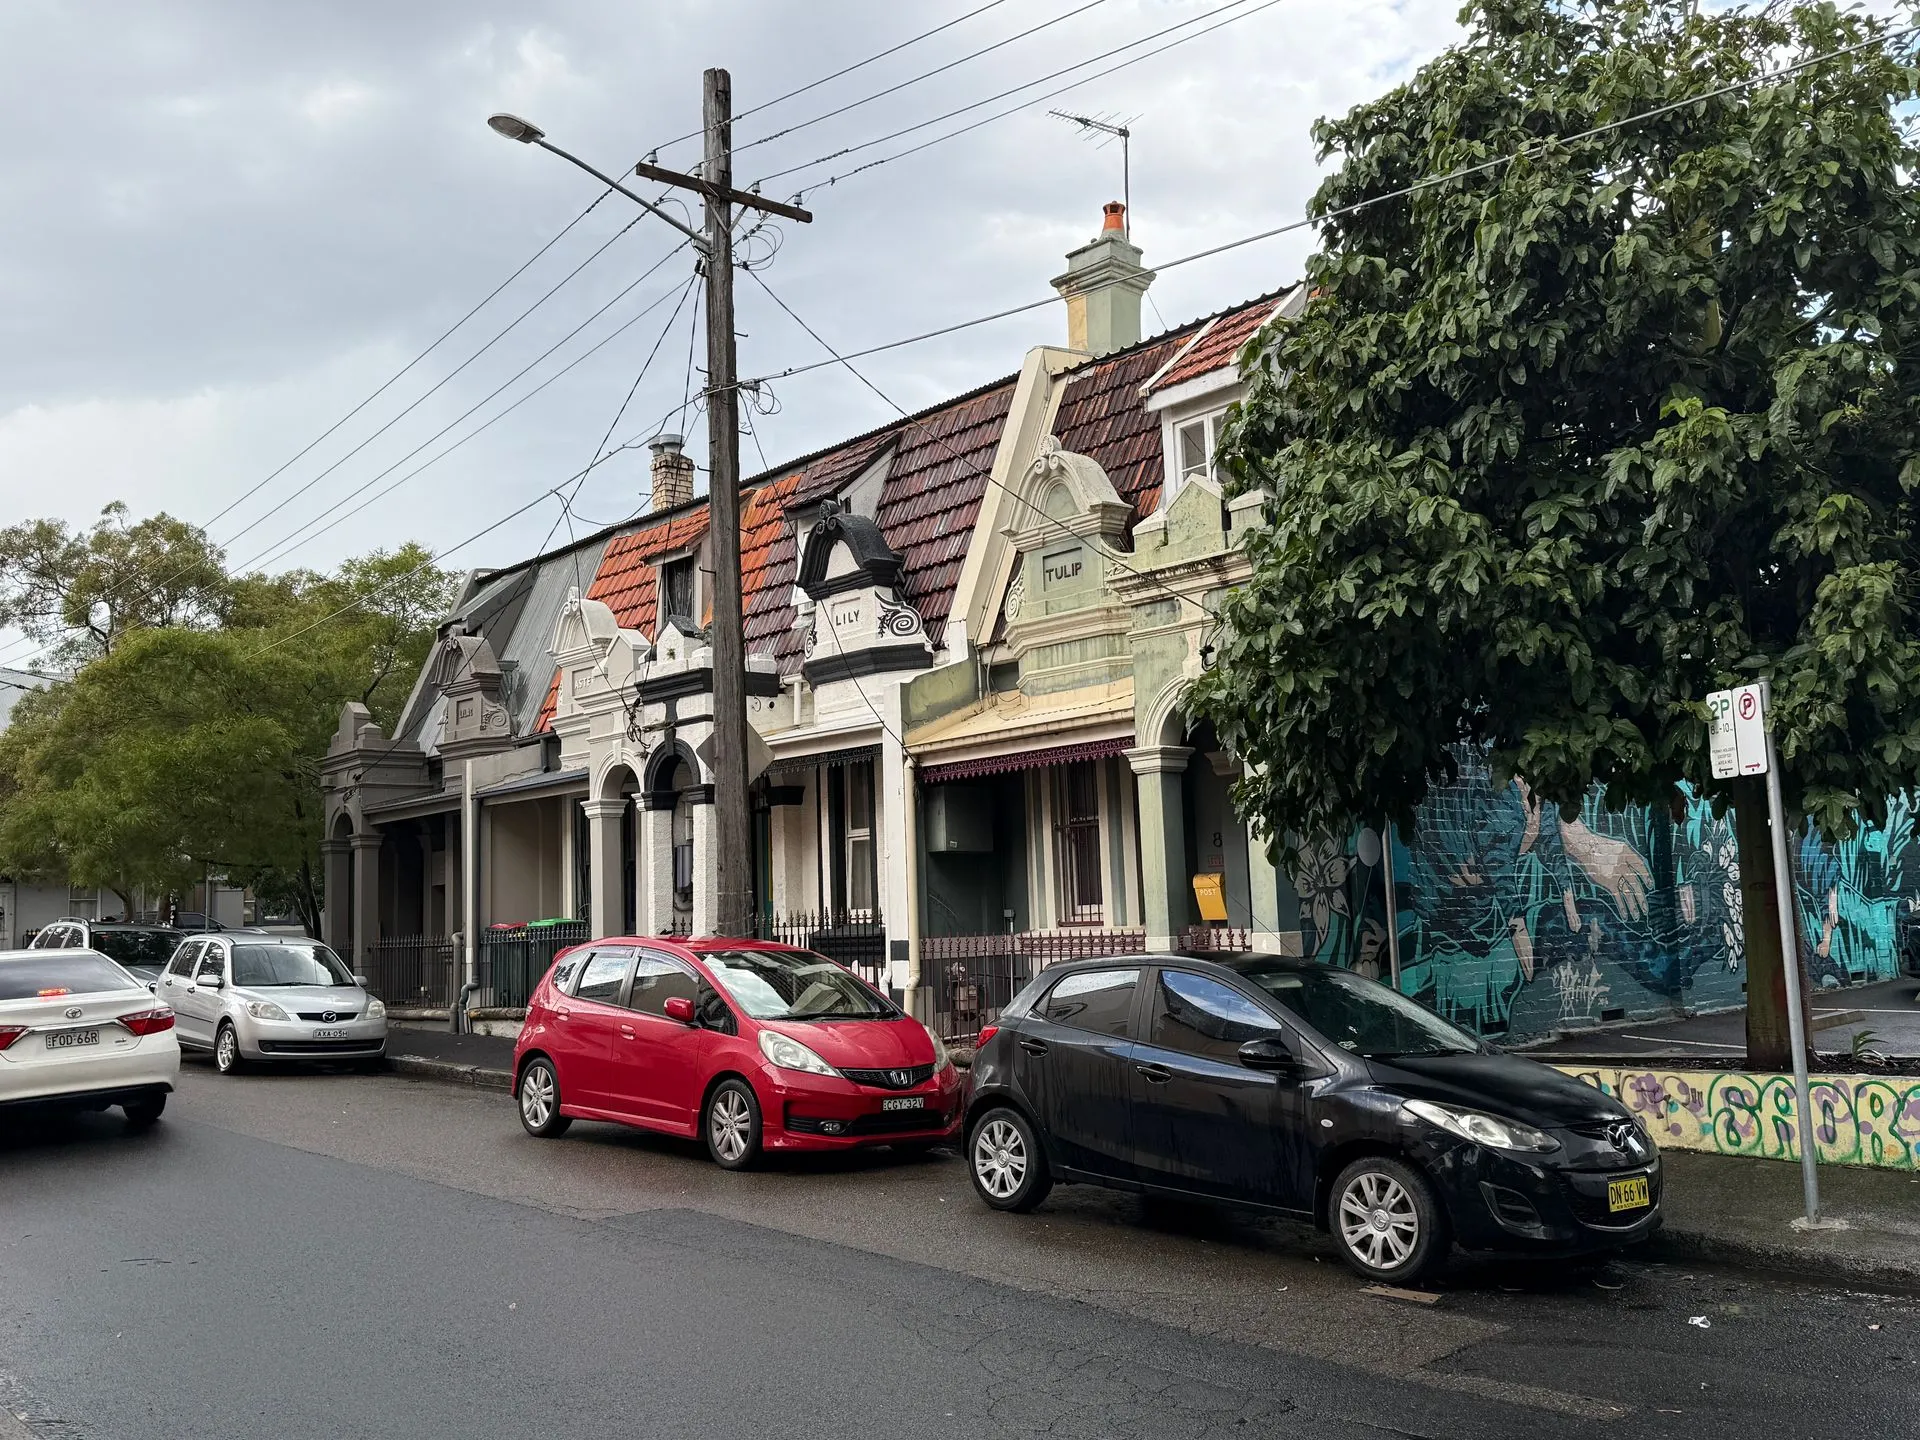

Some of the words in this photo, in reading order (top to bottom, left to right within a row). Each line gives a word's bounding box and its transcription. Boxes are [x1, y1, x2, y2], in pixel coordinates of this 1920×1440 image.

[1045, 562, 1082, 582] TULIP
[835, 609, 860, 626] LILY
[1710, 699, 1730, 720] 2P
[1213, 832, 1222, 848] 8
[1199, 888, 1216, 896] POST
